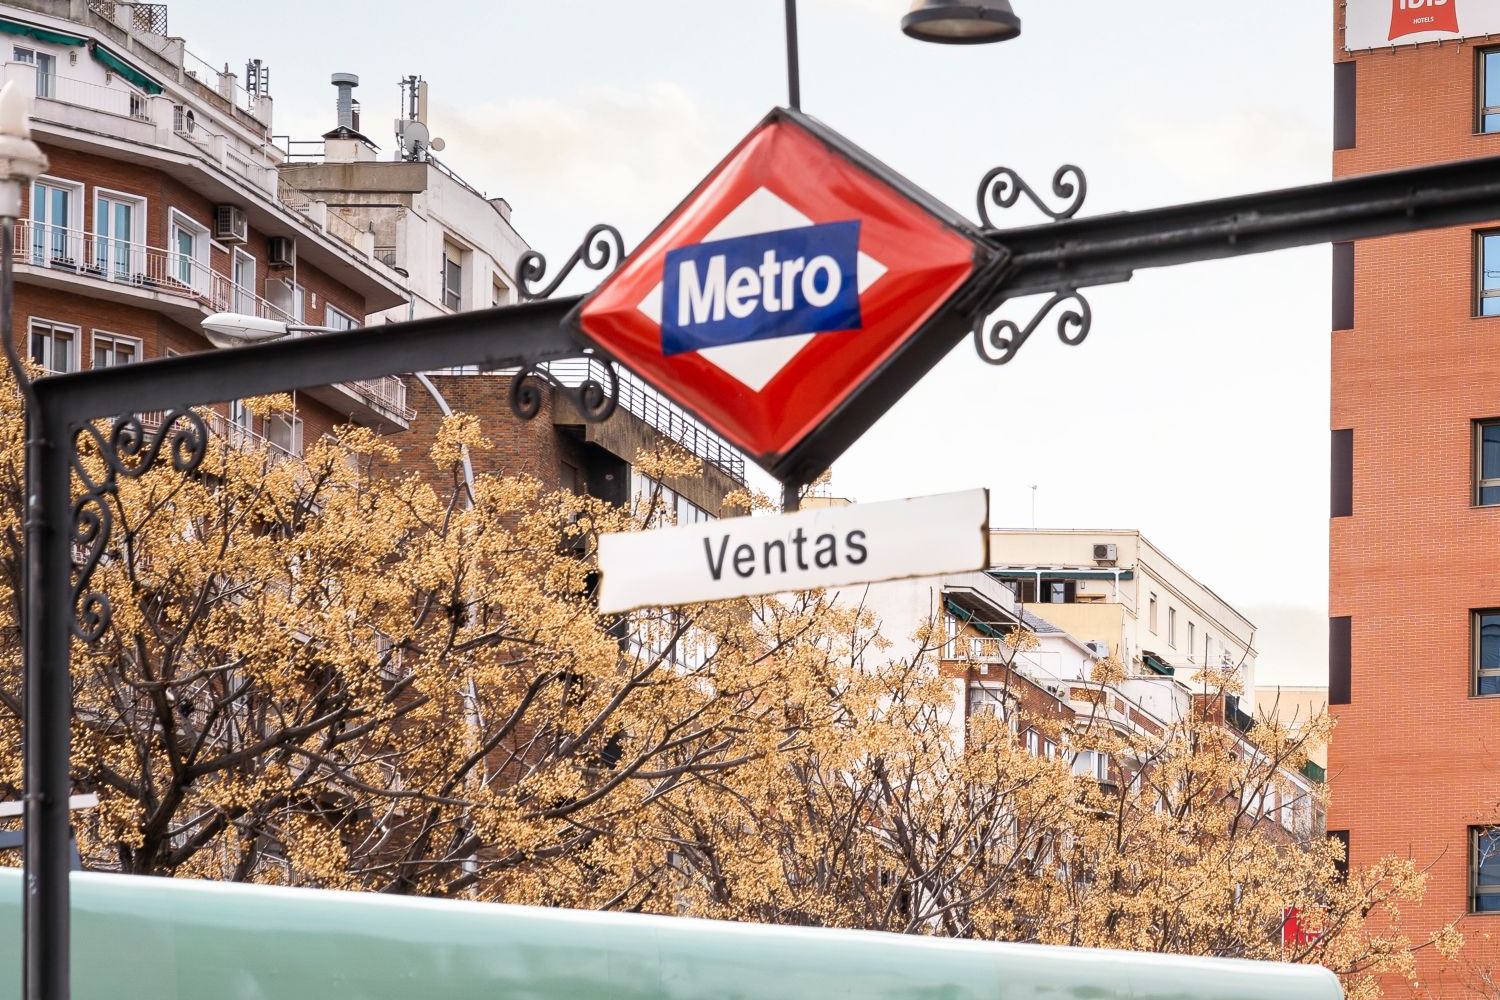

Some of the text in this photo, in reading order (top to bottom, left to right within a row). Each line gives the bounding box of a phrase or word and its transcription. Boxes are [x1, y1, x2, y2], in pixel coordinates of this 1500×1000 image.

[1412, 16, 1435, 25] HOTELS
[678, 249, 842, 327] Metro
[703, 527, 869, 581] Ventas
